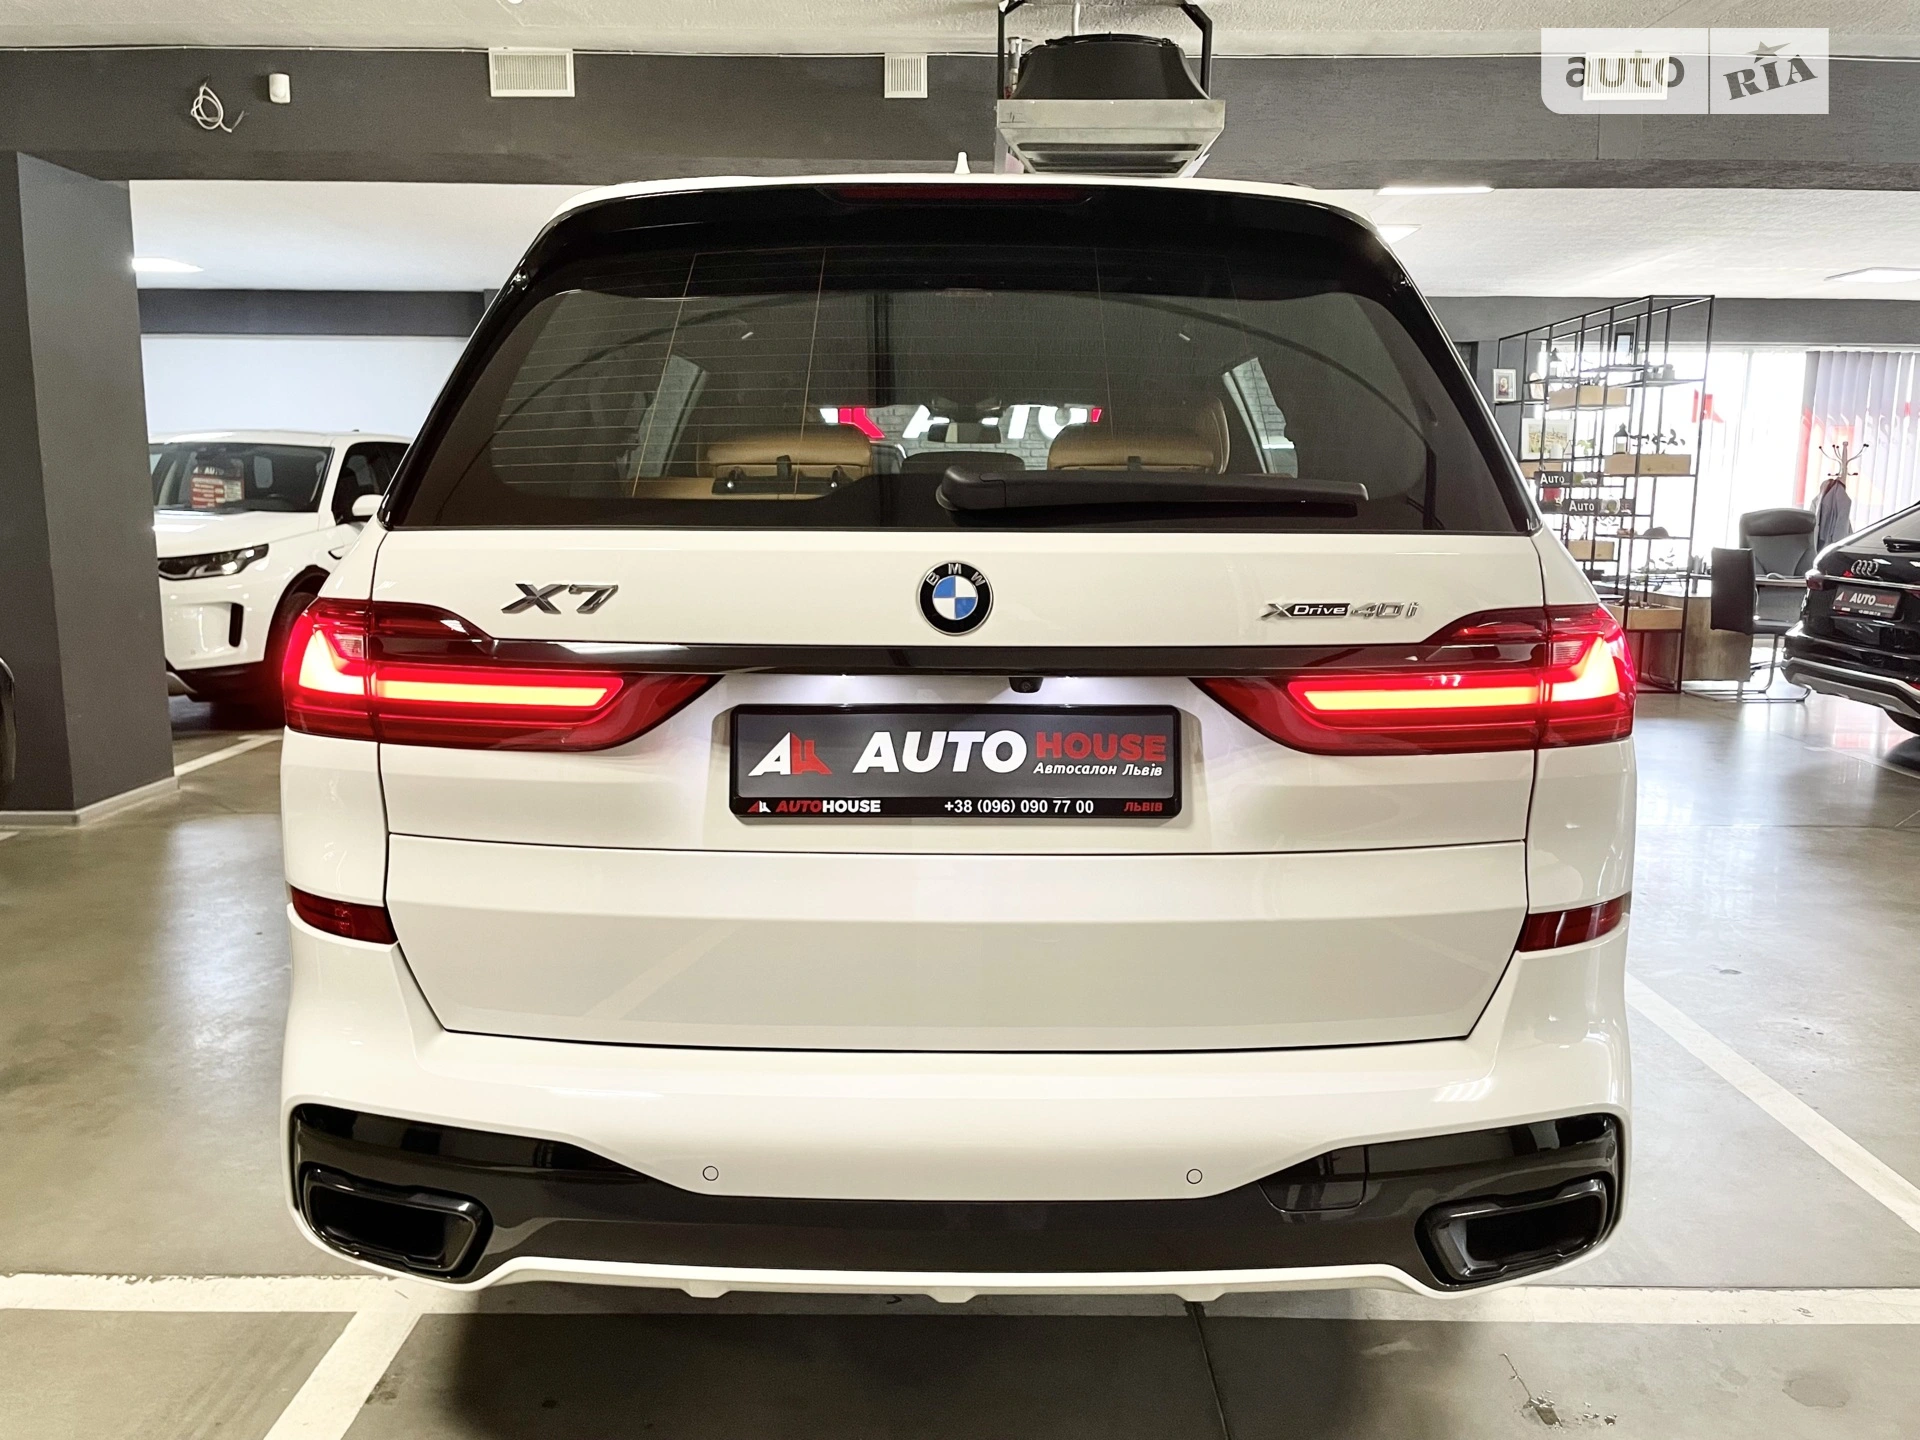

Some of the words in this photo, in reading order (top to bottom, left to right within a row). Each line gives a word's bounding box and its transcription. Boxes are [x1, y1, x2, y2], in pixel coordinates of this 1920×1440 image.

[926, 562, 986, 586] BMW
[501, 583, 619, 614] X7
[1849, 592, 1876, 606] AUTO
[852, 730, 1027, 773] AUTO
[1036, 731, 1167, 762] HOUSE
[1033, 762, 1118, 775] Автосалон
[1122, 763, 1163, 777] Львів
[944, 800, 973, 813] +38
[977, 799, 1015, 813] (096)
[1020, 800, 1048, 813] 090
[1053, 800, 1071, 813] 77
[1075, 800, 1094, 813] 00
